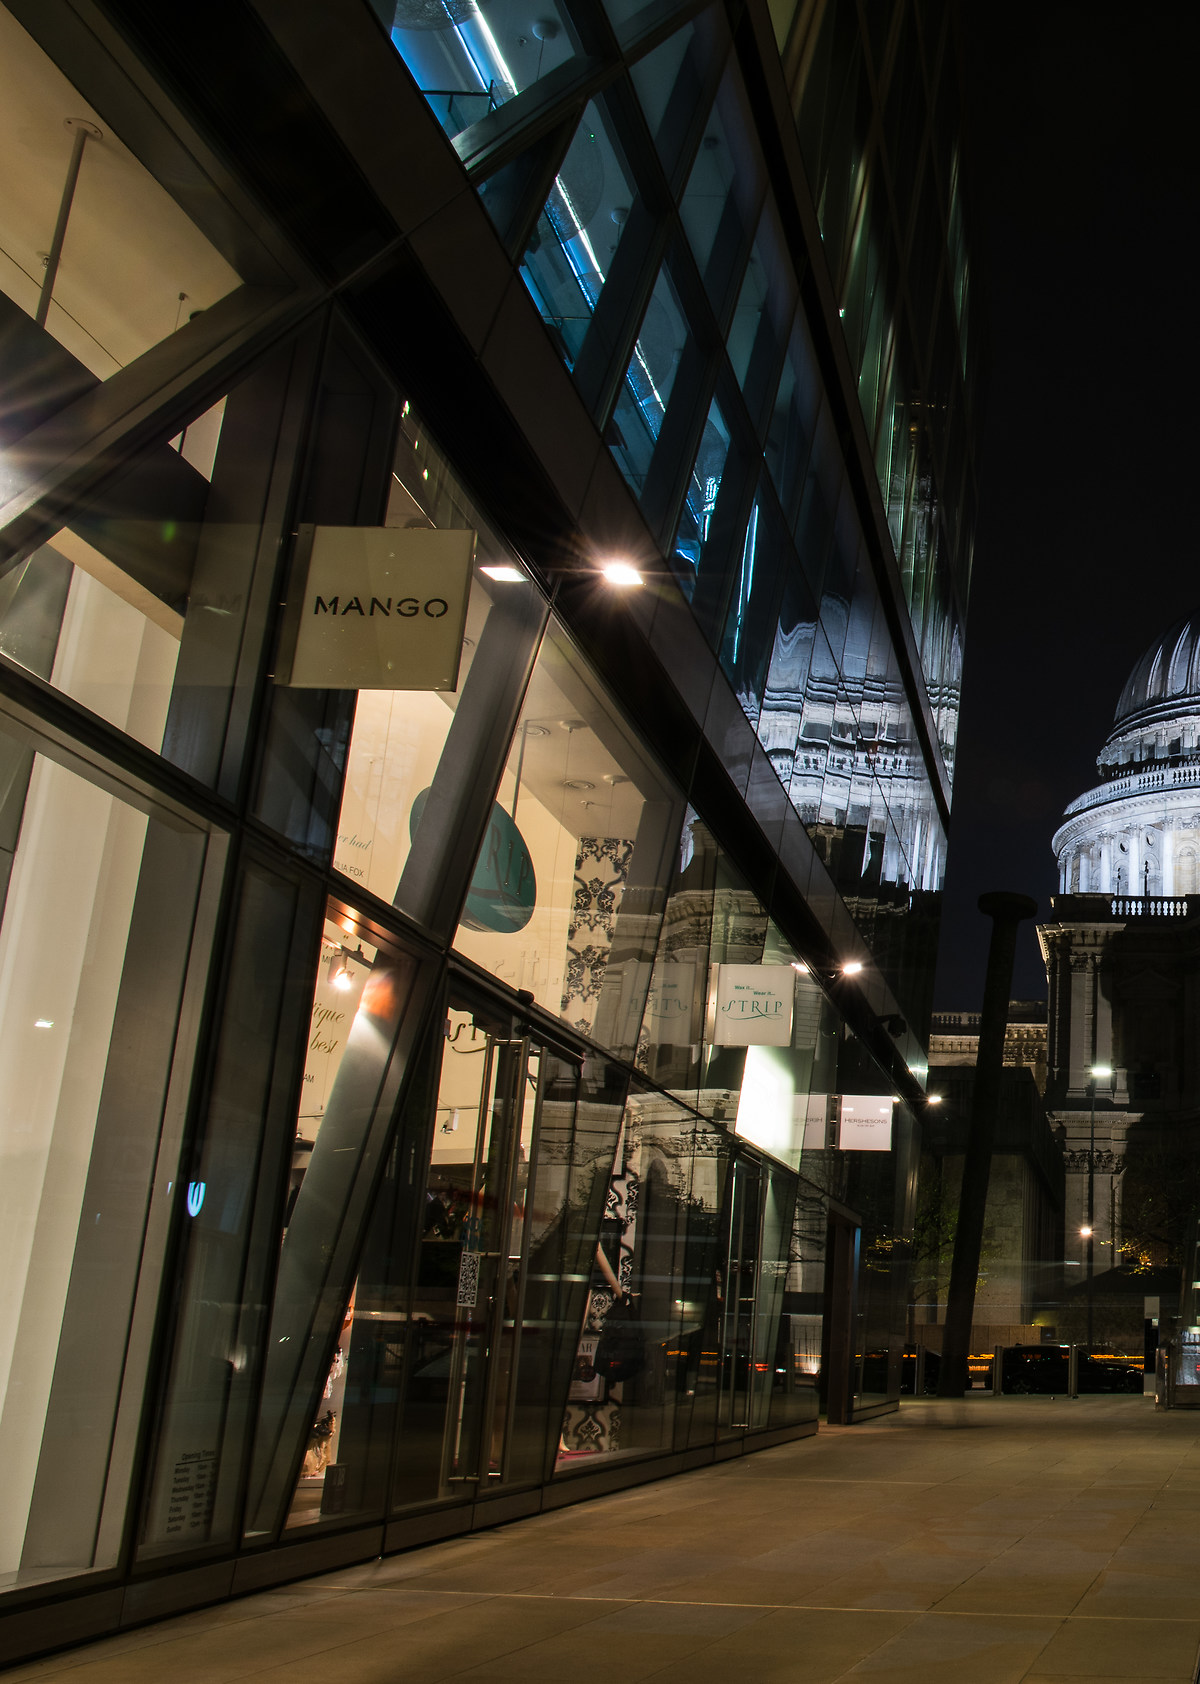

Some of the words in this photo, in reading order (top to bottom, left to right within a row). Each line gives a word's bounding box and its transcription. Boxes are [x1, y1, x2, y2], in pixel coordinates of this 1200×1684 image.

[314, 596, 449, 618] MANGO
[486, 822, 530, 895] RIP
[349, 866, 365, 878] FOX
[313, 1003, 345, 1028] ique
[722, 1000, 782, 1014] STRIP
[310, 1031, 338, 1055] best
[844, 1117, 887, 1125] HERSHESONS
